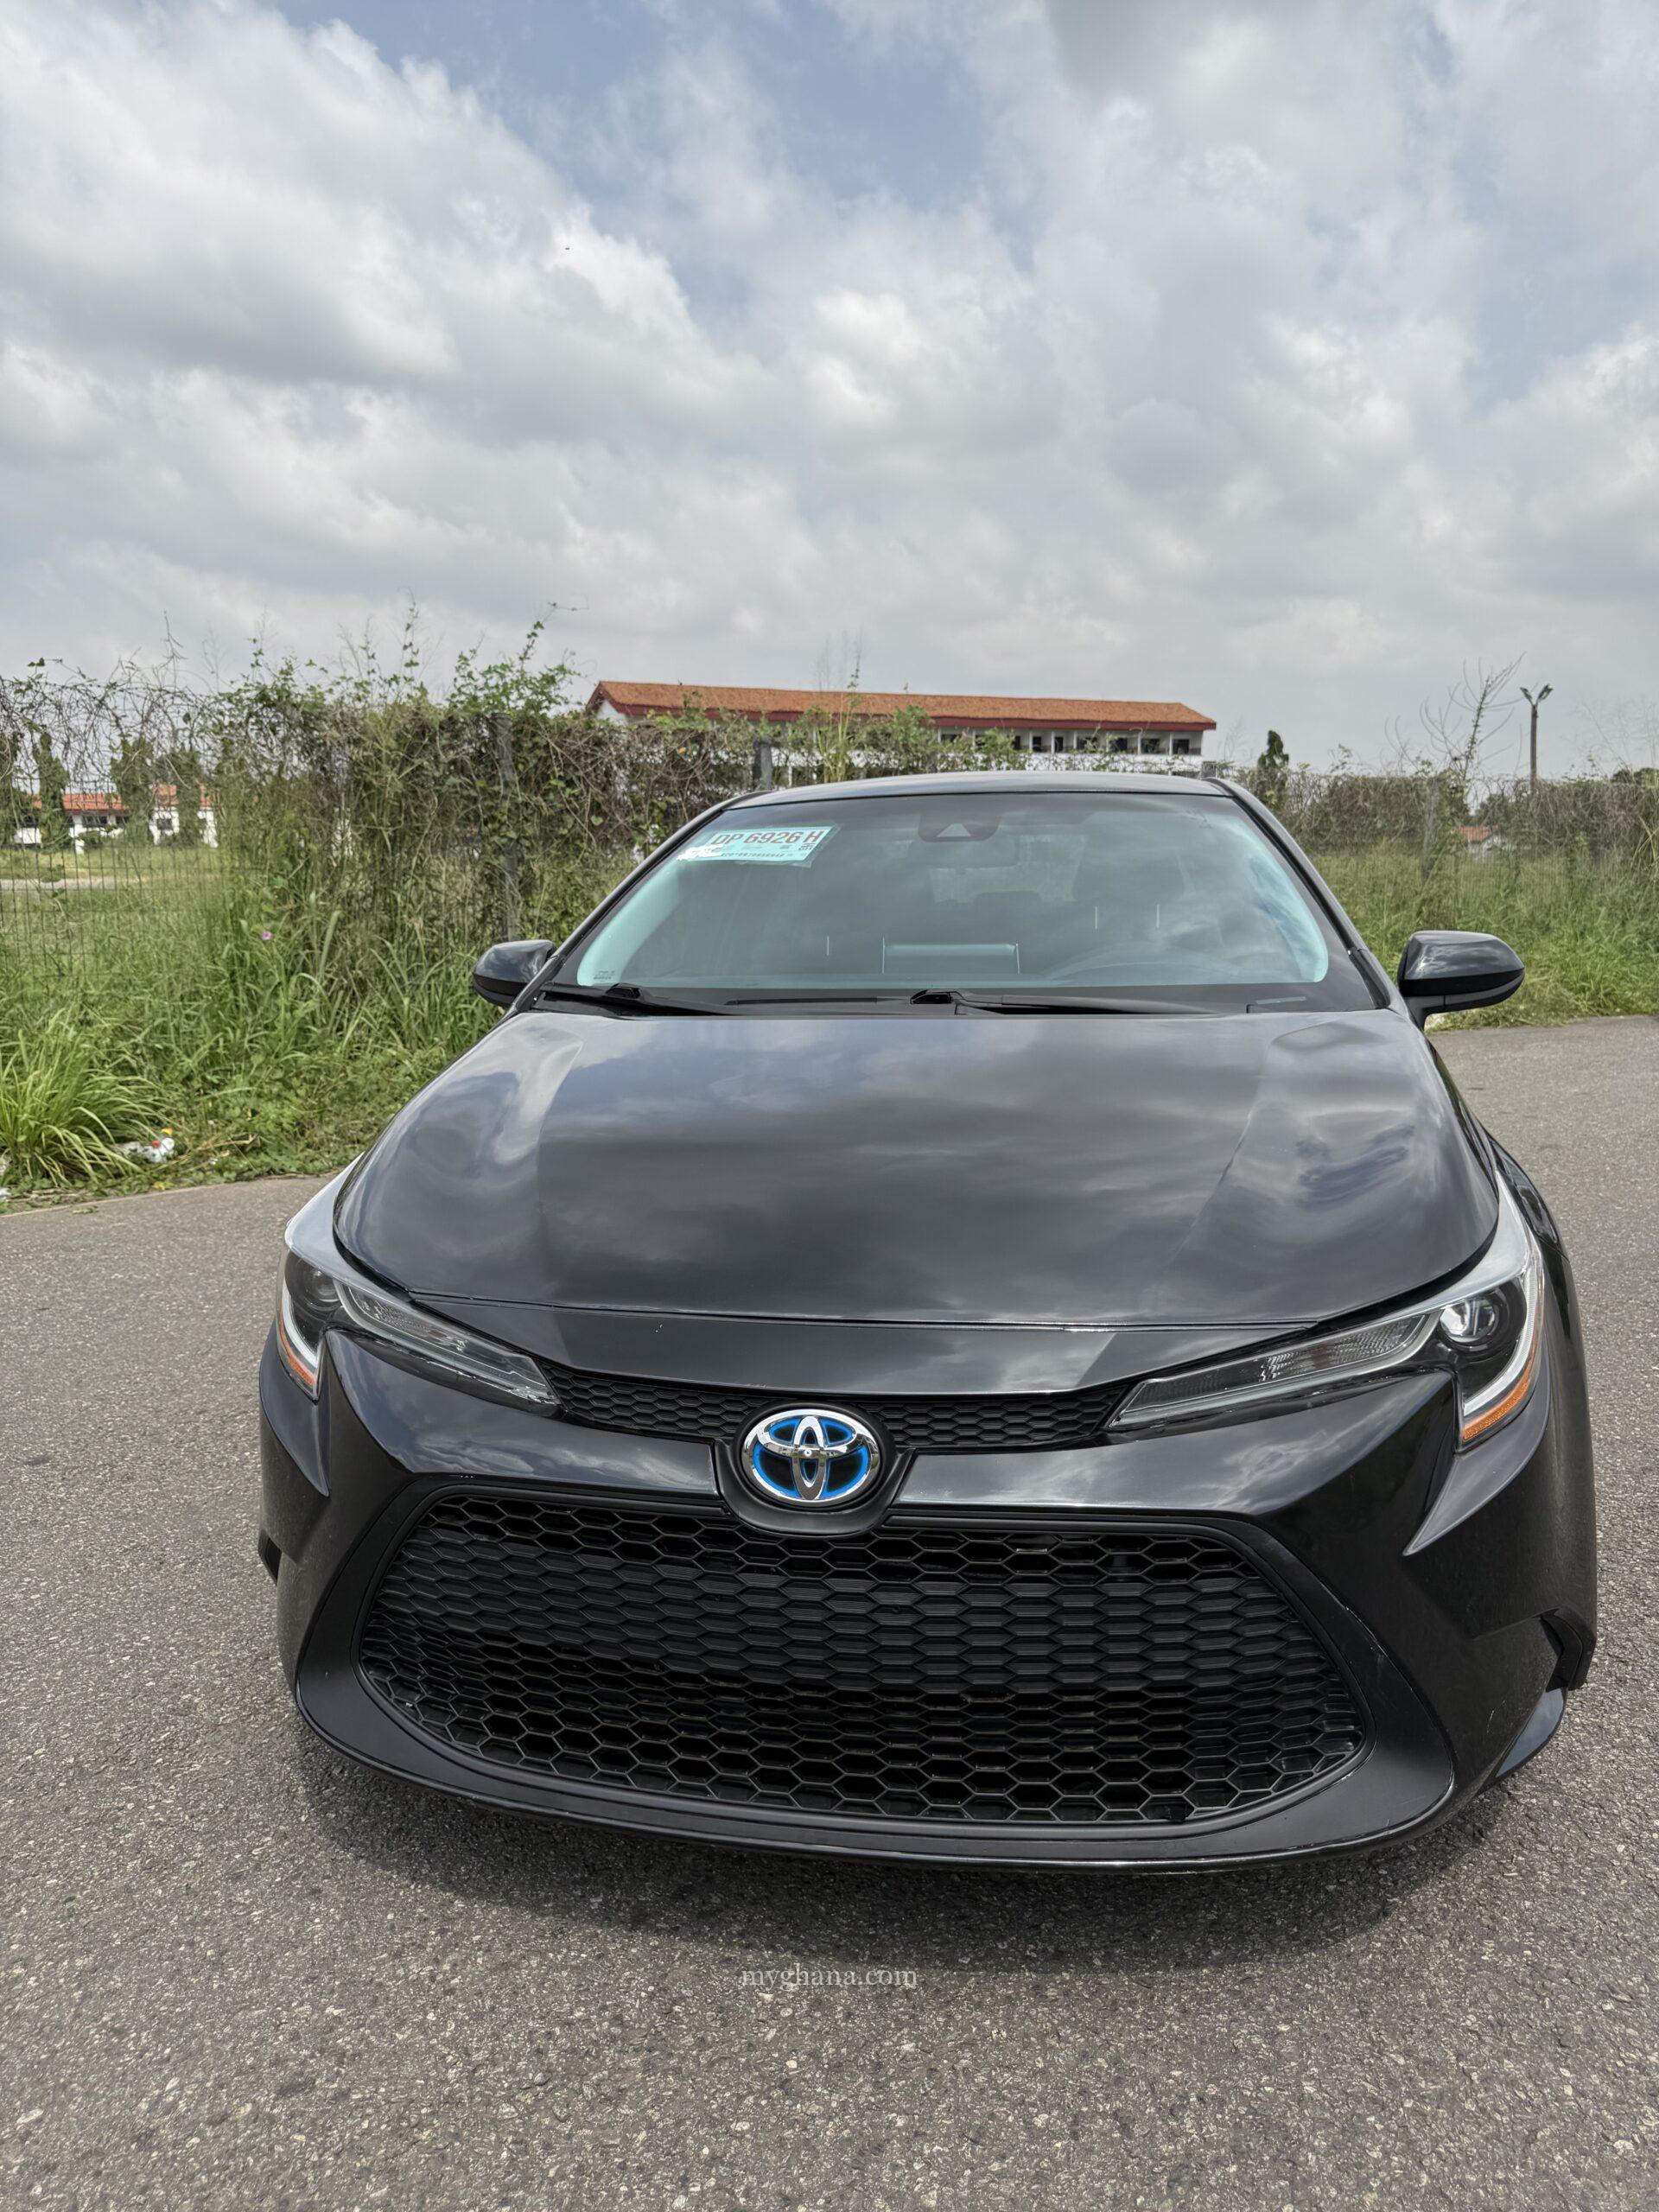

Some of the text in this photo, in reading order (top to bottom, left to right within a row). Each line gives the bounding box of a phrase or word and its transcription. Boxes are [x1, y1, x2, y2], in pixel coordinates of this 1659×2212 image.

[711, 830, 824, 845] DP 6926 H
